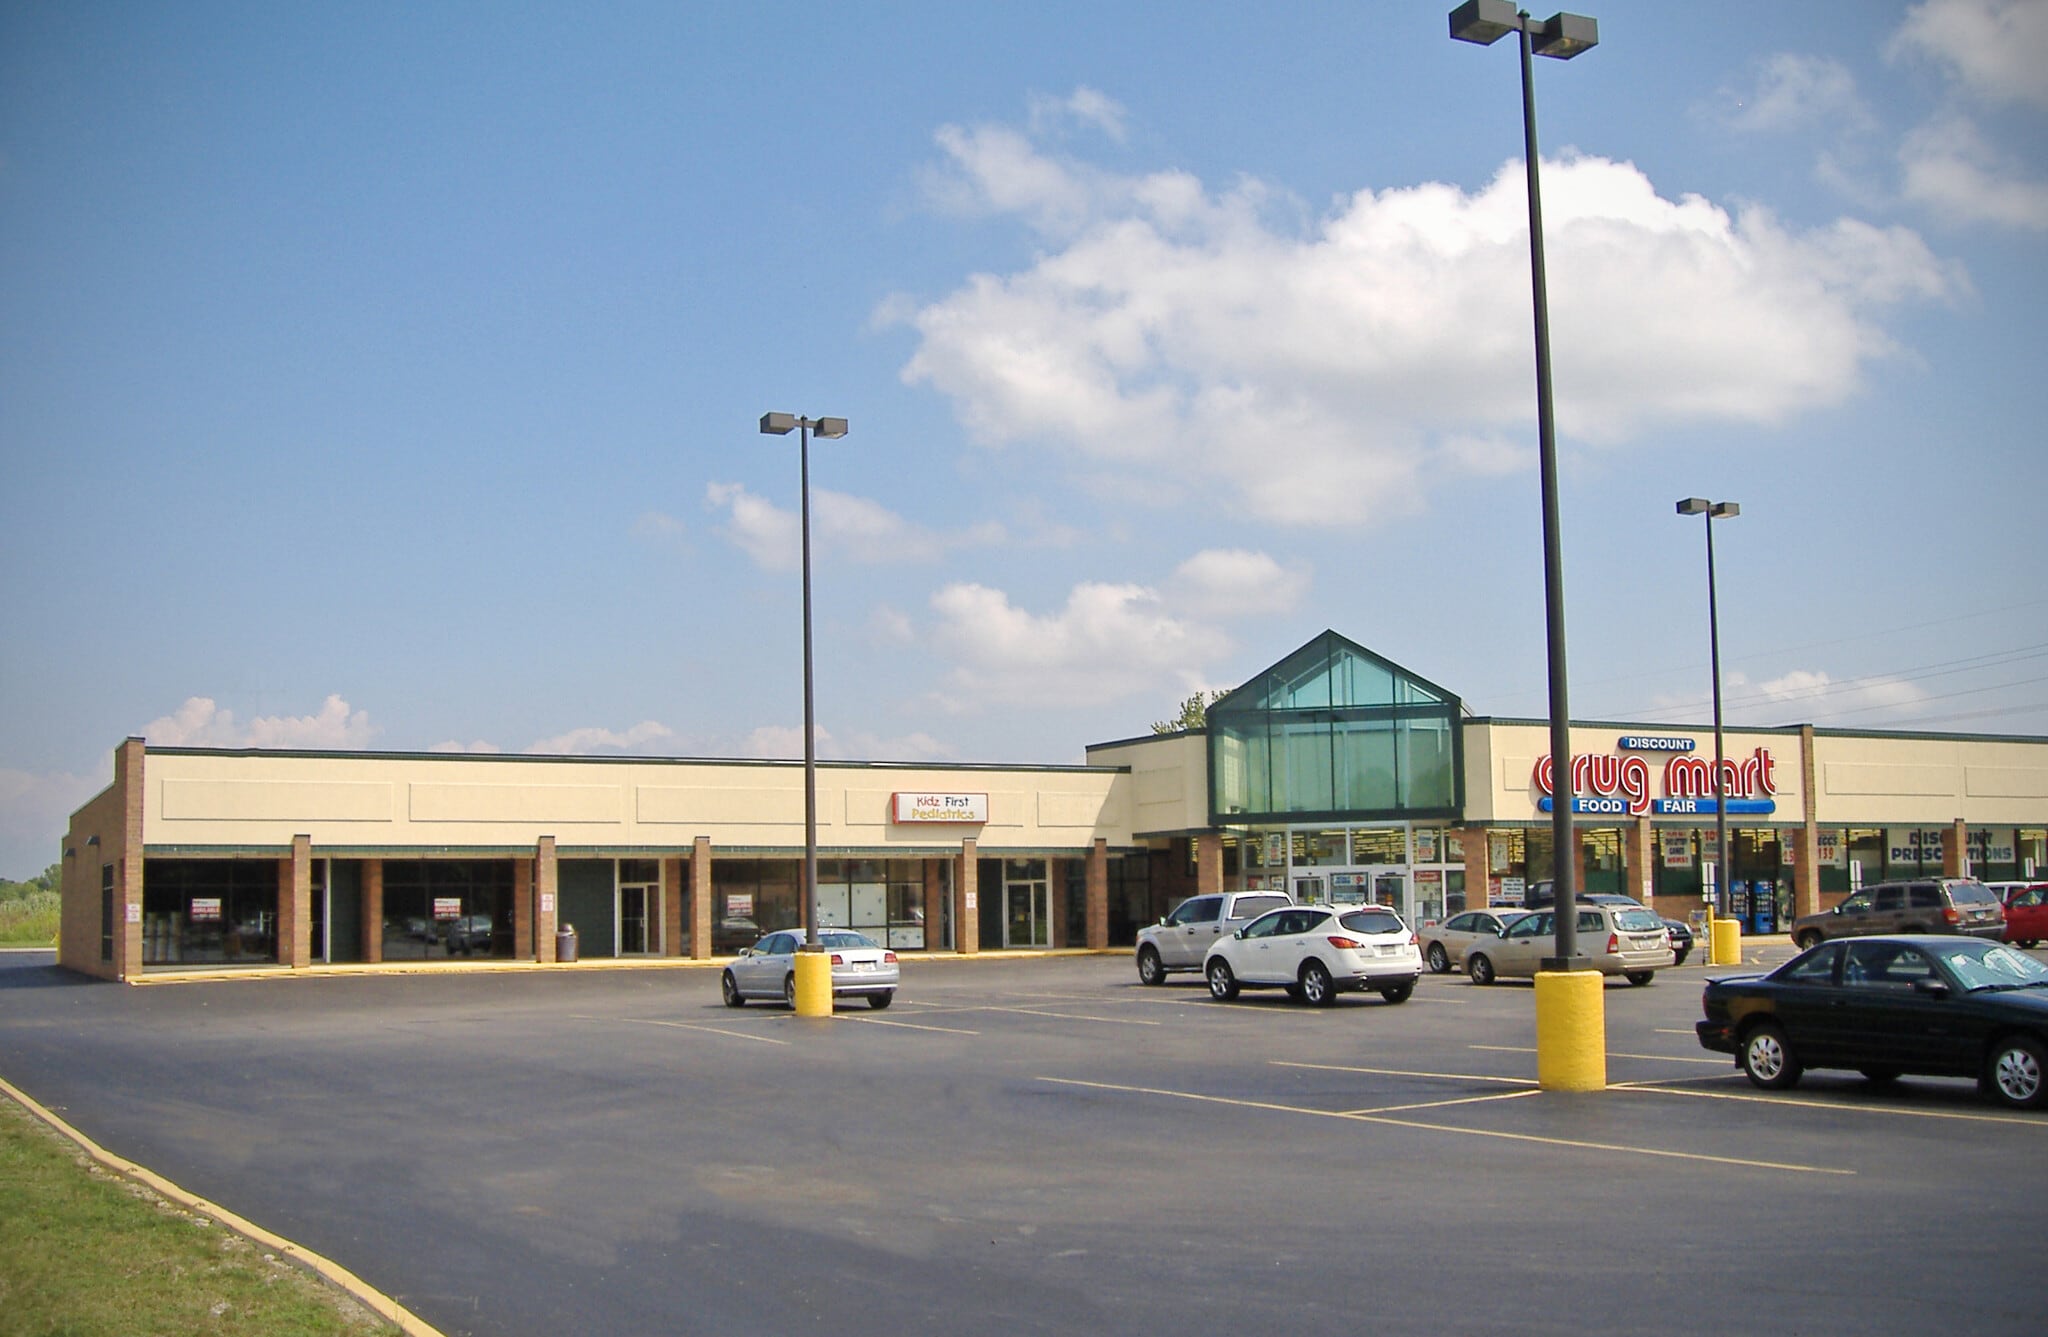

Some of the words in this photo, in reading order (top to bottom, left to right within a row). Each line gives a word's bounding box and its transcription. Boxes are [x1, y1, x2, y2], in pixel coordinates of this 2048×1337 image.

[1628, 737, 1693, 750] DISCOUNT
[1664, 747, 1776, 798] mart
[916, 796, 941, 807] Kidz
[945, 796, 969, 807] First
[1578, 799, 1623, 812] FOOD
[1663, 799, 1697, 812] FAIR
[911, 808, 975, 819] Pediatrics
